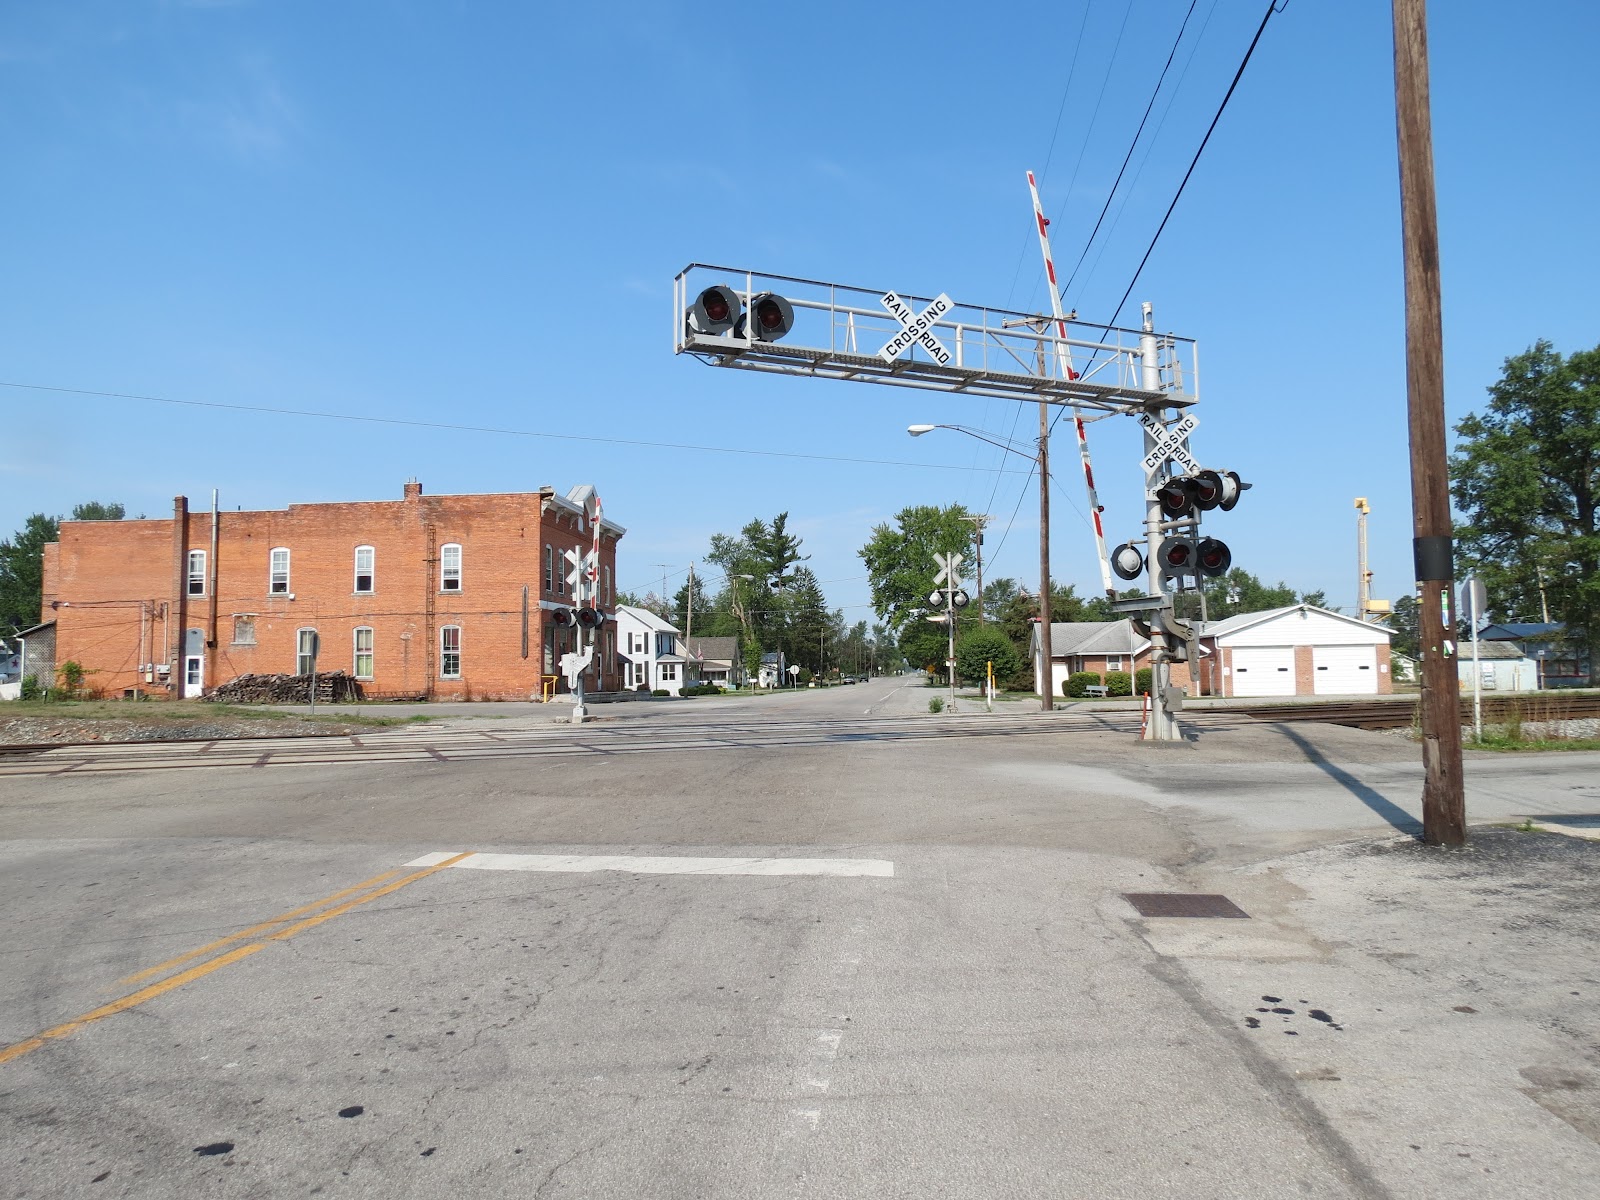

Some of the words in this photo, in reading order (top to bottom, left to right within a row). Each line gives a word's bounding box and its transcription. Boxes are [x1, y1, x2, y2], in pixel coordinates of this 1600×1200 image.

[884, 294, 909, 324] RAIL
[918, 332, 949, 363] ROAD
[886, 301, 946, 356] CROSSING
[1141, 415, 1162, 441] RAIL
[1145, 419, 1194, 468] CROSSING
